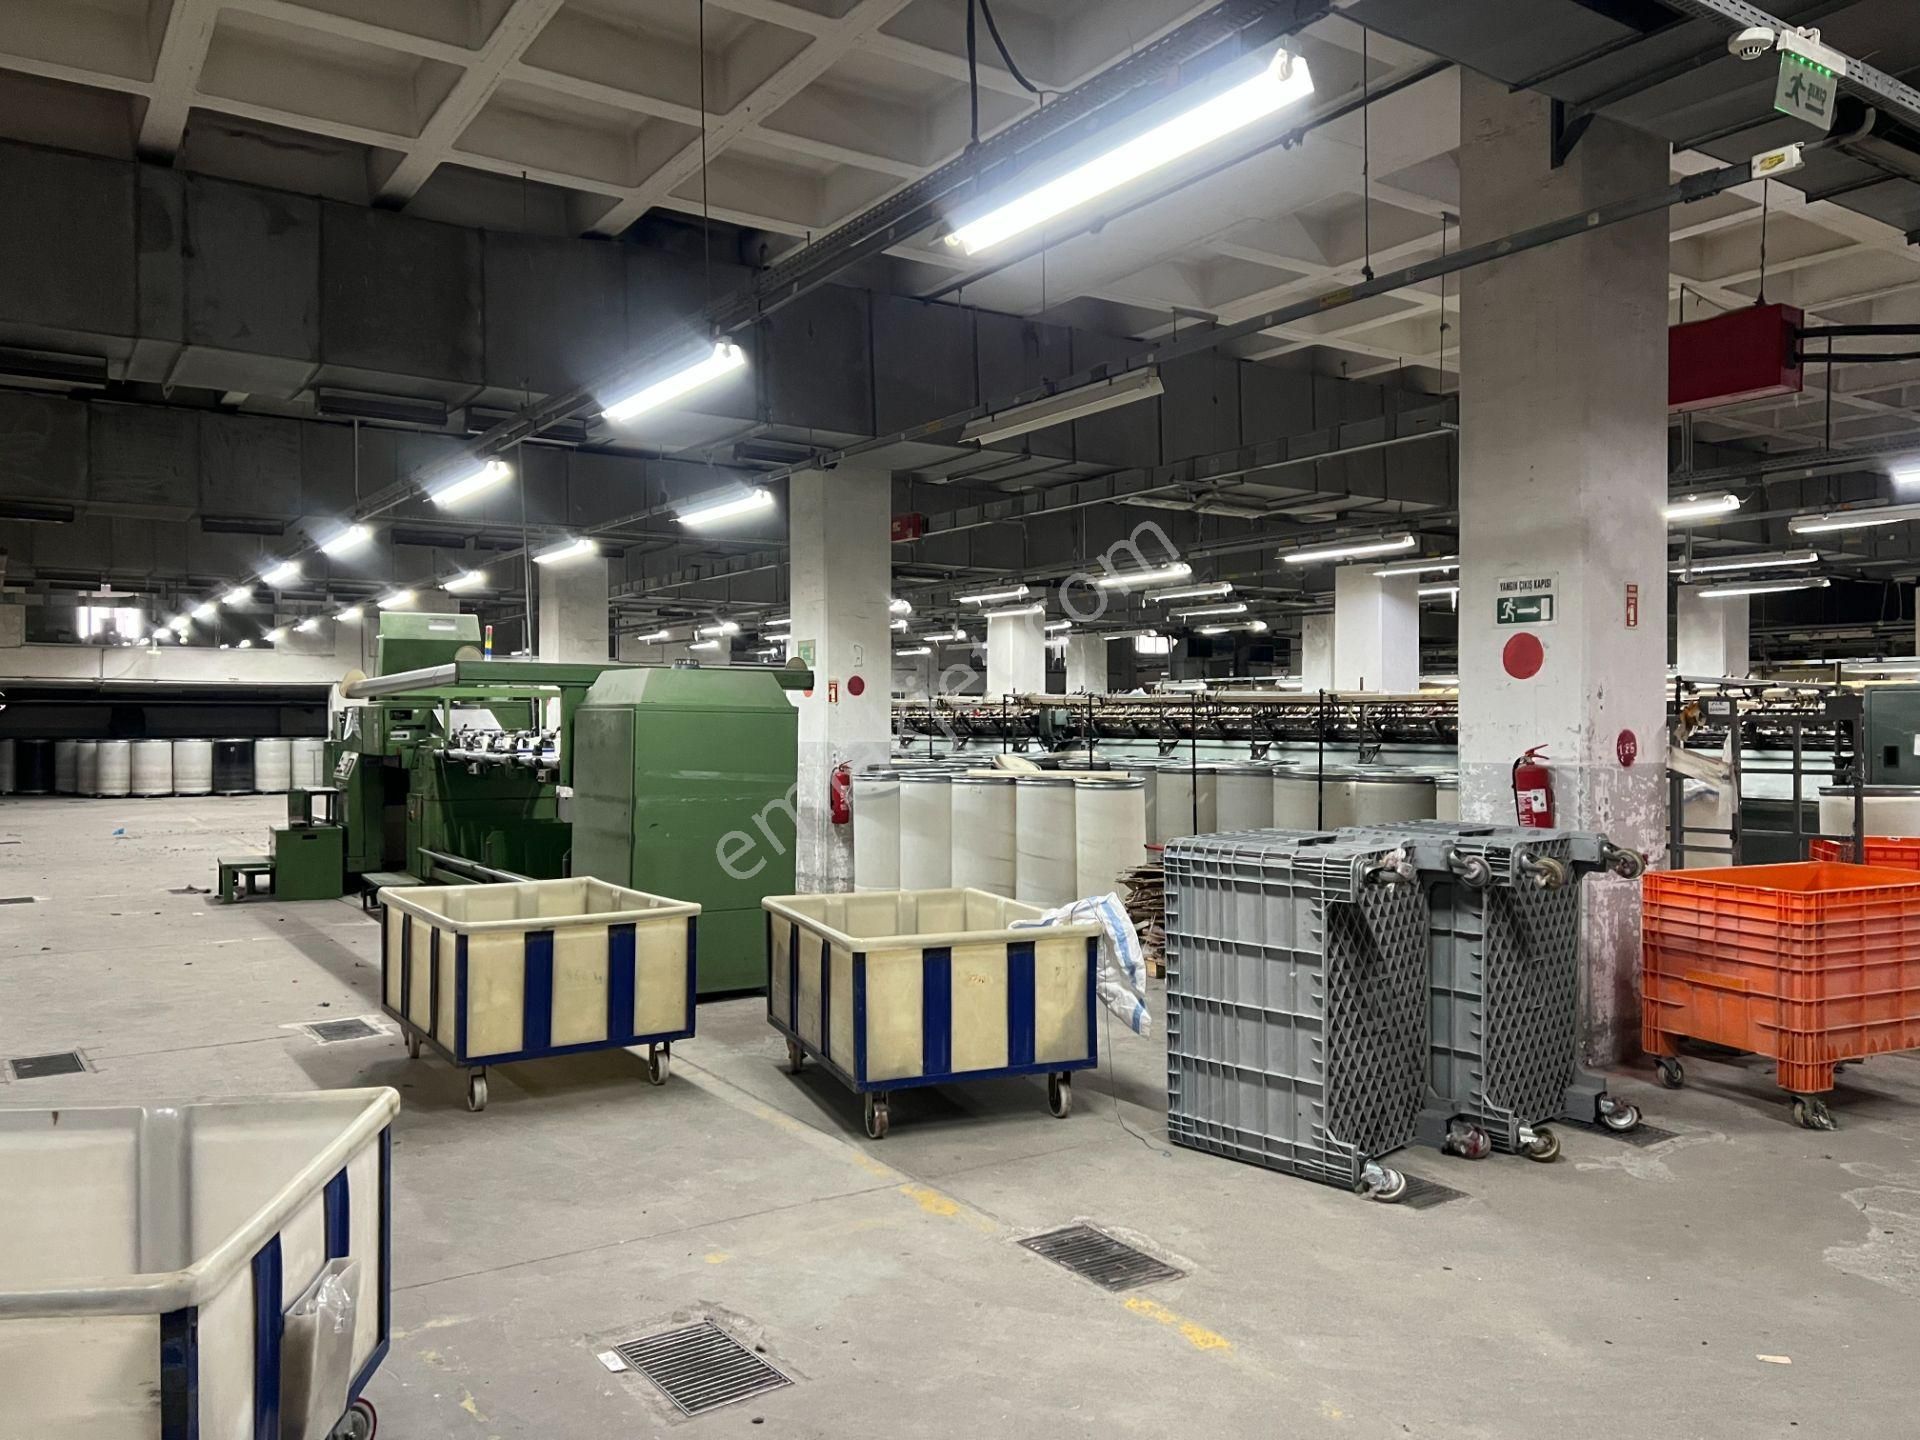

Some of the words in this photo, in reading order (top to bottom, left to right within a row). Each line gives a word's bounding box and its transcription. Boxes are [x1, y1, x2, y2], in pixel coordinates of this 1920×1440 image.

[1500, 581, 1518, 592] YANGIN
[1519, 580, 1533, 593] ÇIKIŞ
[1534, 578, 1552, 589] KAPISI
